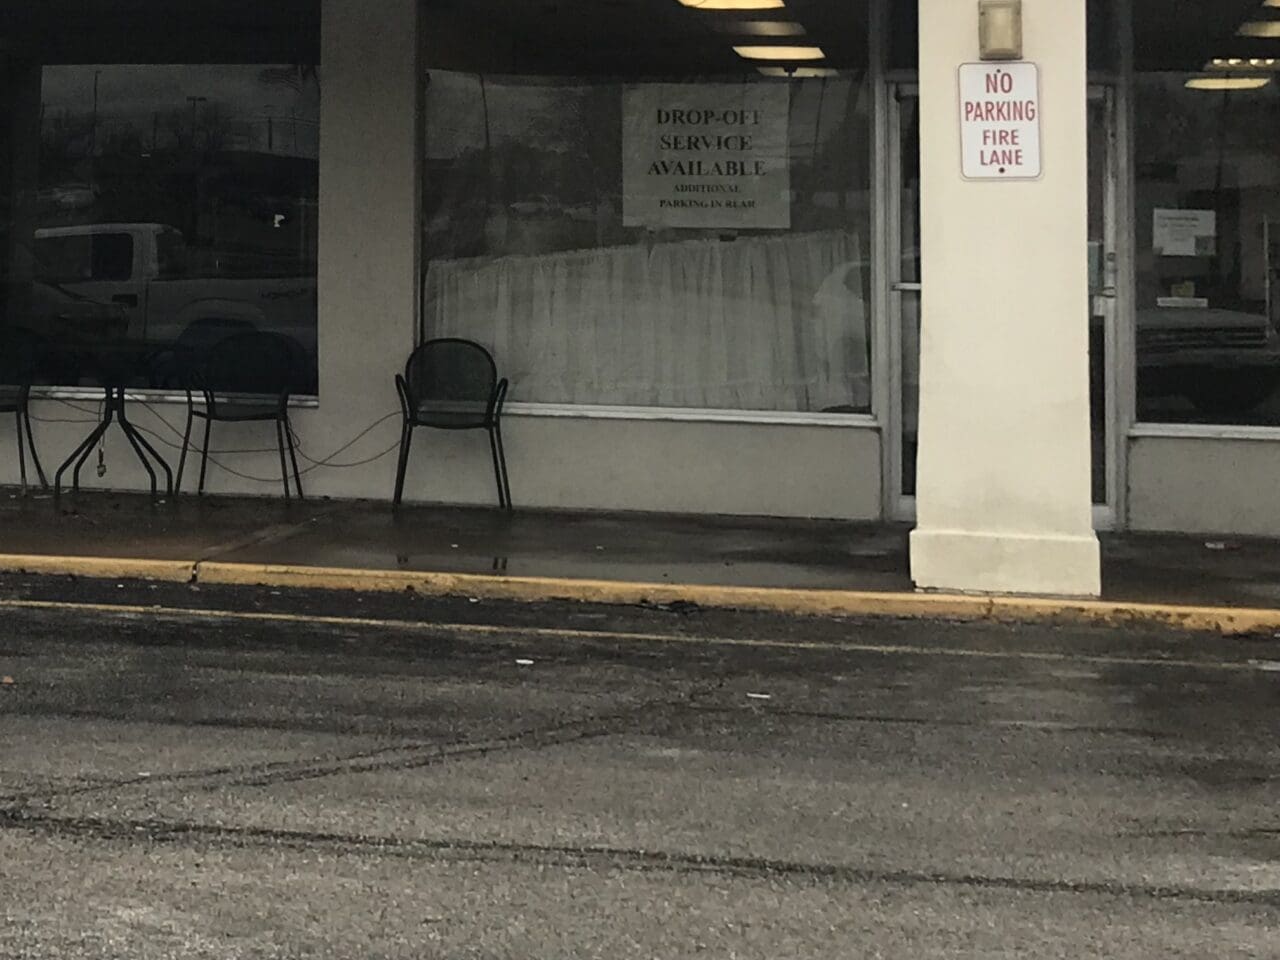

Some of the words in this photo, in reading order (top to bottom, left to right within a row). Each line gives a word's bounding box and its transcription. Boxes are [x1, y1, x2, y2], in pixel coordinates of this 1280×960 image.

[985, 72, 1013, 94] NO
[964, 100, 1036, 122] PARKING
[659, 135, 753, 151] SERVICE
[982, 129, 1020, 146] FIRE
[979, 149, 1023, 166] LANE
[647, 160, 768, 177] AVAILABLE
[659, 199, 709, 209] PARKING
[710, 200, 723, 209] IN
